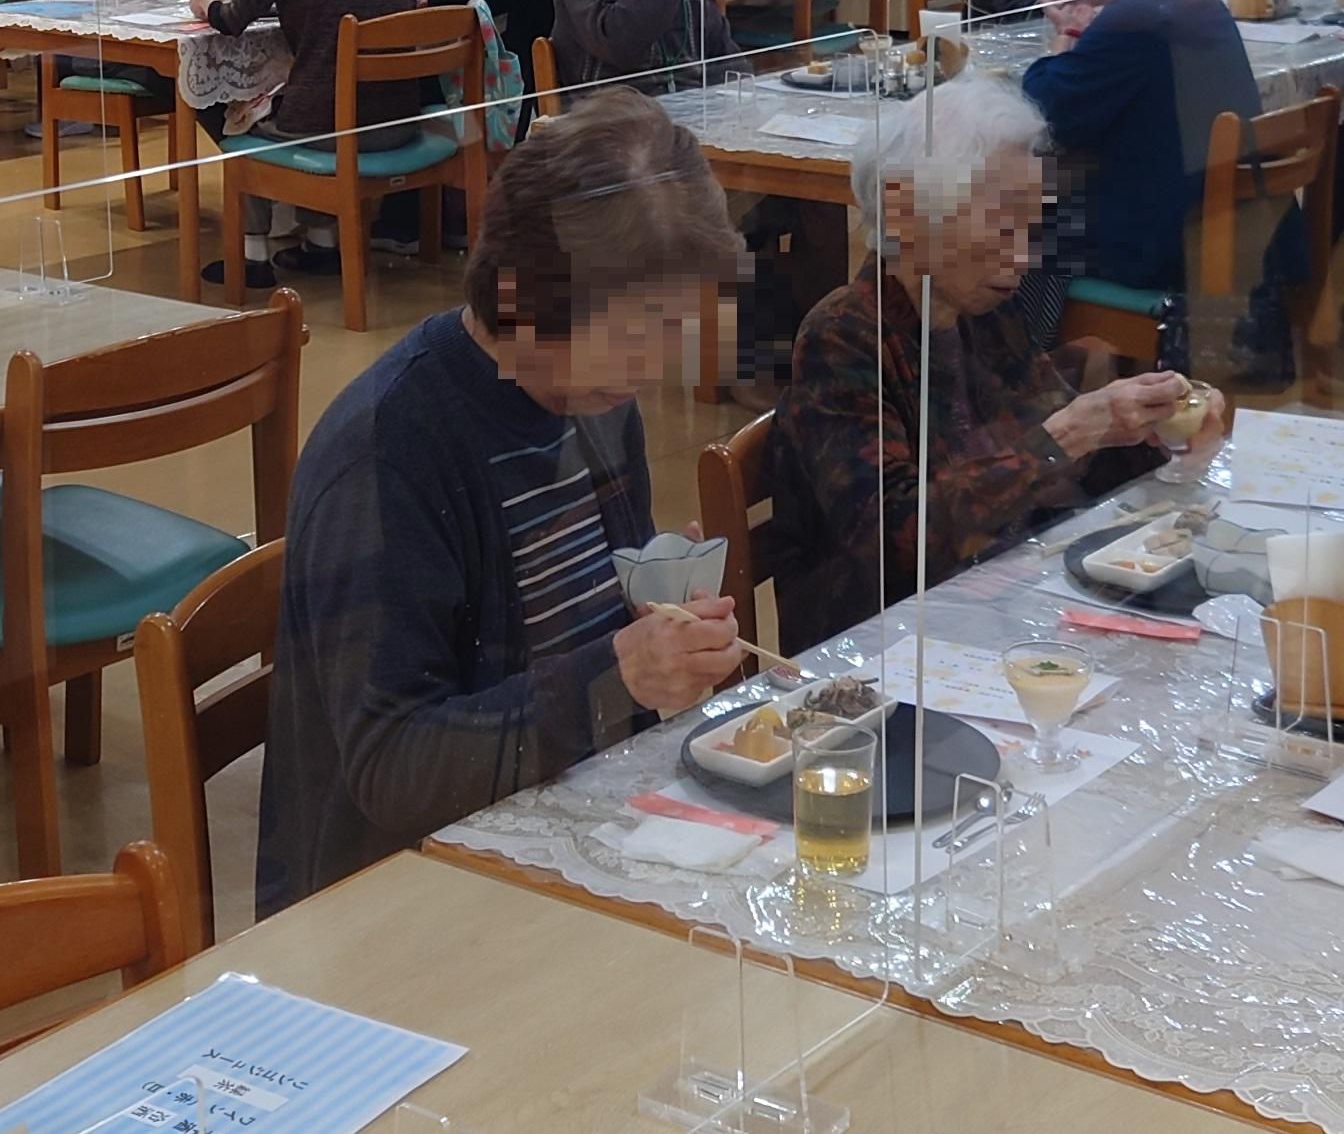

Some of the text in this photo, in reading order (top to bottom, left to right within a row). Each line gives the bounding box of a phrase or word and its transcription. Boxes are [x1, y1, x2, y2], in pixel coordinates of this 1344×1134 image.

[202, 1049, 309, 1089] リンゴジュース
[213, 1079, 251, 1096] 緑茶
